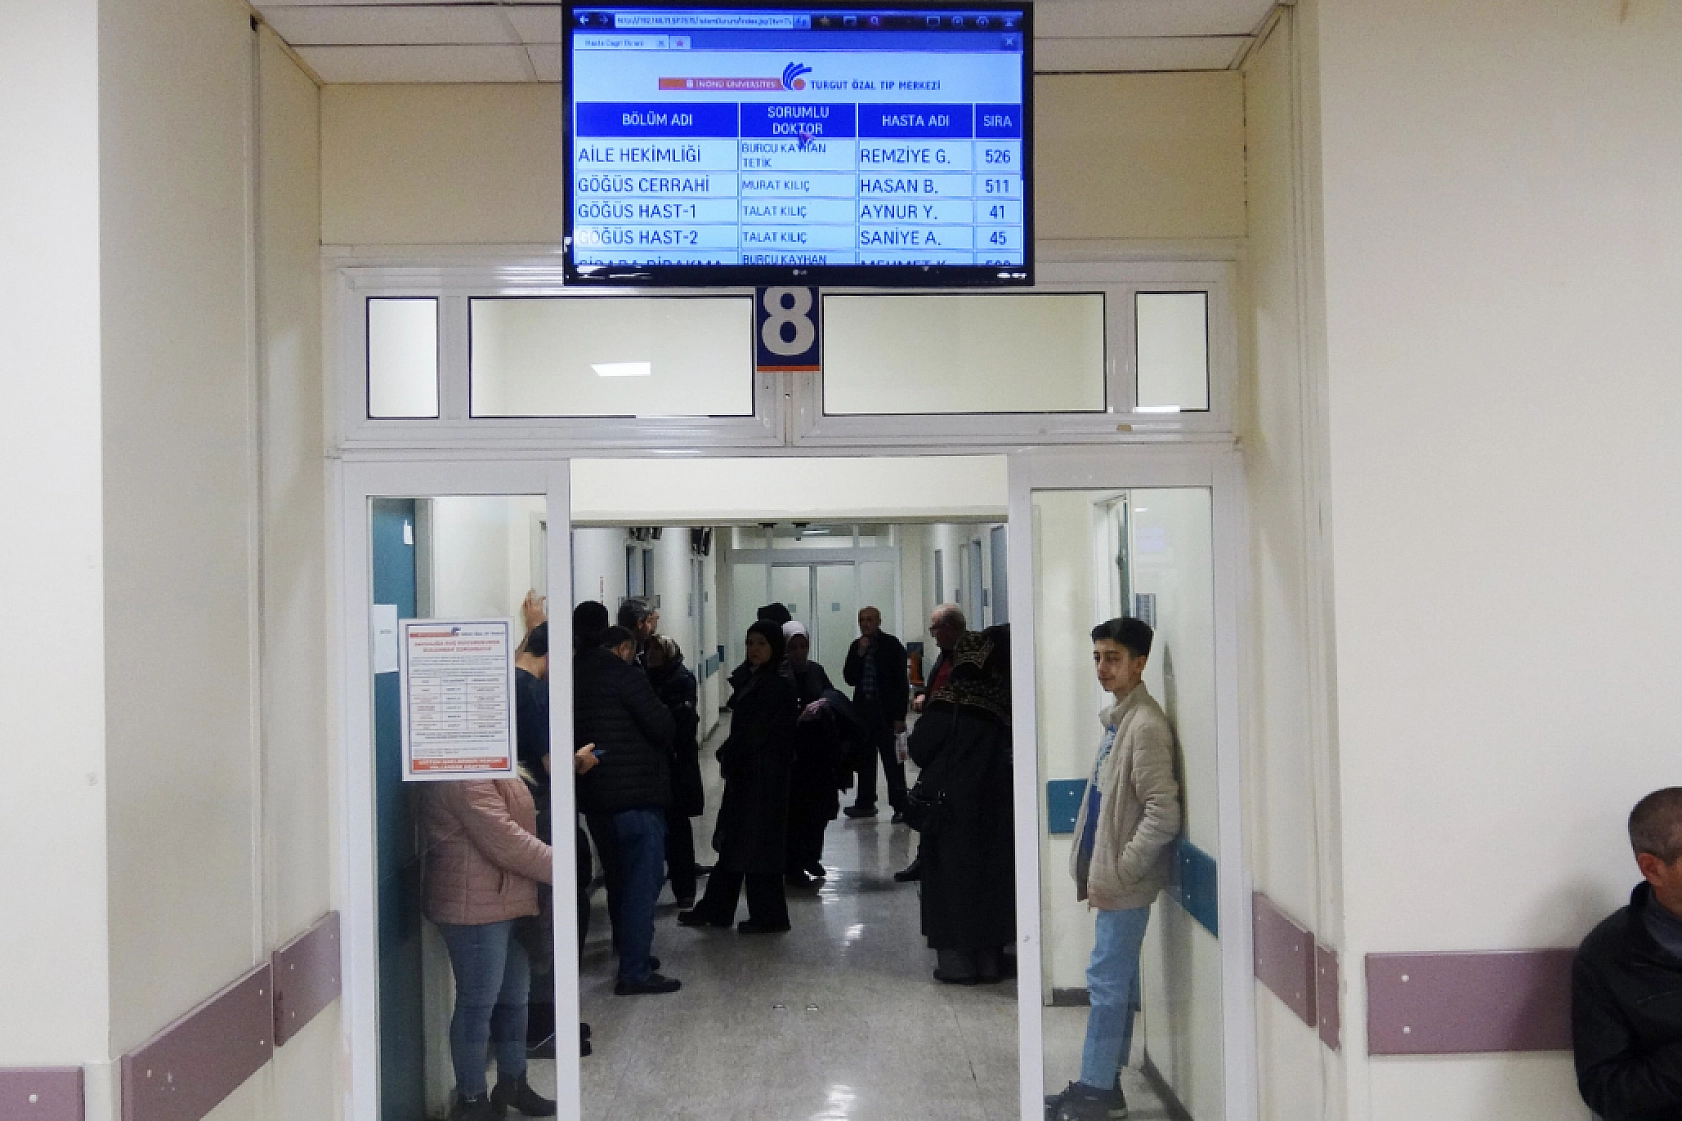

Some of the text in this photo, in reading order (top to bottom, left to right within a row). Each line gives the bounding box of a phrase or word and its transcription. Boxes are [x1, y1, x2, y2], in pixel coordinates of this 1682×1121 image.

[811, 78, 941, 91] TURGUT ÖZAL TIP MERKEZİ
[622, 110, 693, 127] BÖLÜM ADI
[767, 105, 830, 119] SORUMLU
[881, 113, 949, 127] HASTA ADI
[983, 114, 1013, 127] SIRA
[772, 122, 823, 135] DOKTOR
[578, 144, 701, 163] AİLE HEKİMLİĞİ
[741, 143, 779, 153] BURCU
[860, 145, 951, 164] REMZİYE G.
[985, 149, 1011, 163] 526
[578, 174, 710, 193] GÖĞÜS CERRAHİ
[741, 180, 810, 193] MURAT KILIÇ
[860, 179, 939, 194] HASAN B.
[985, 179, 1010, 194] 511
[578, 200, 696, 219] GÖĞÜS HAST-1
[743, 205, 807, 219] TALAT KILIÇ
[860, 204, 938, 220] AYNUR Y.
[989, 205, 1005, 219] 41
[638, 229, 699, 245] HAST-2
[743, 231, 808, 245] TALAT KILIÇ
[860, 227, 942, 246] SANİYE A.
[989, 231, 1008, 245] 45
[780, 254, 827, 266] KAYHAN
[761, 286, 815, 356] 8
